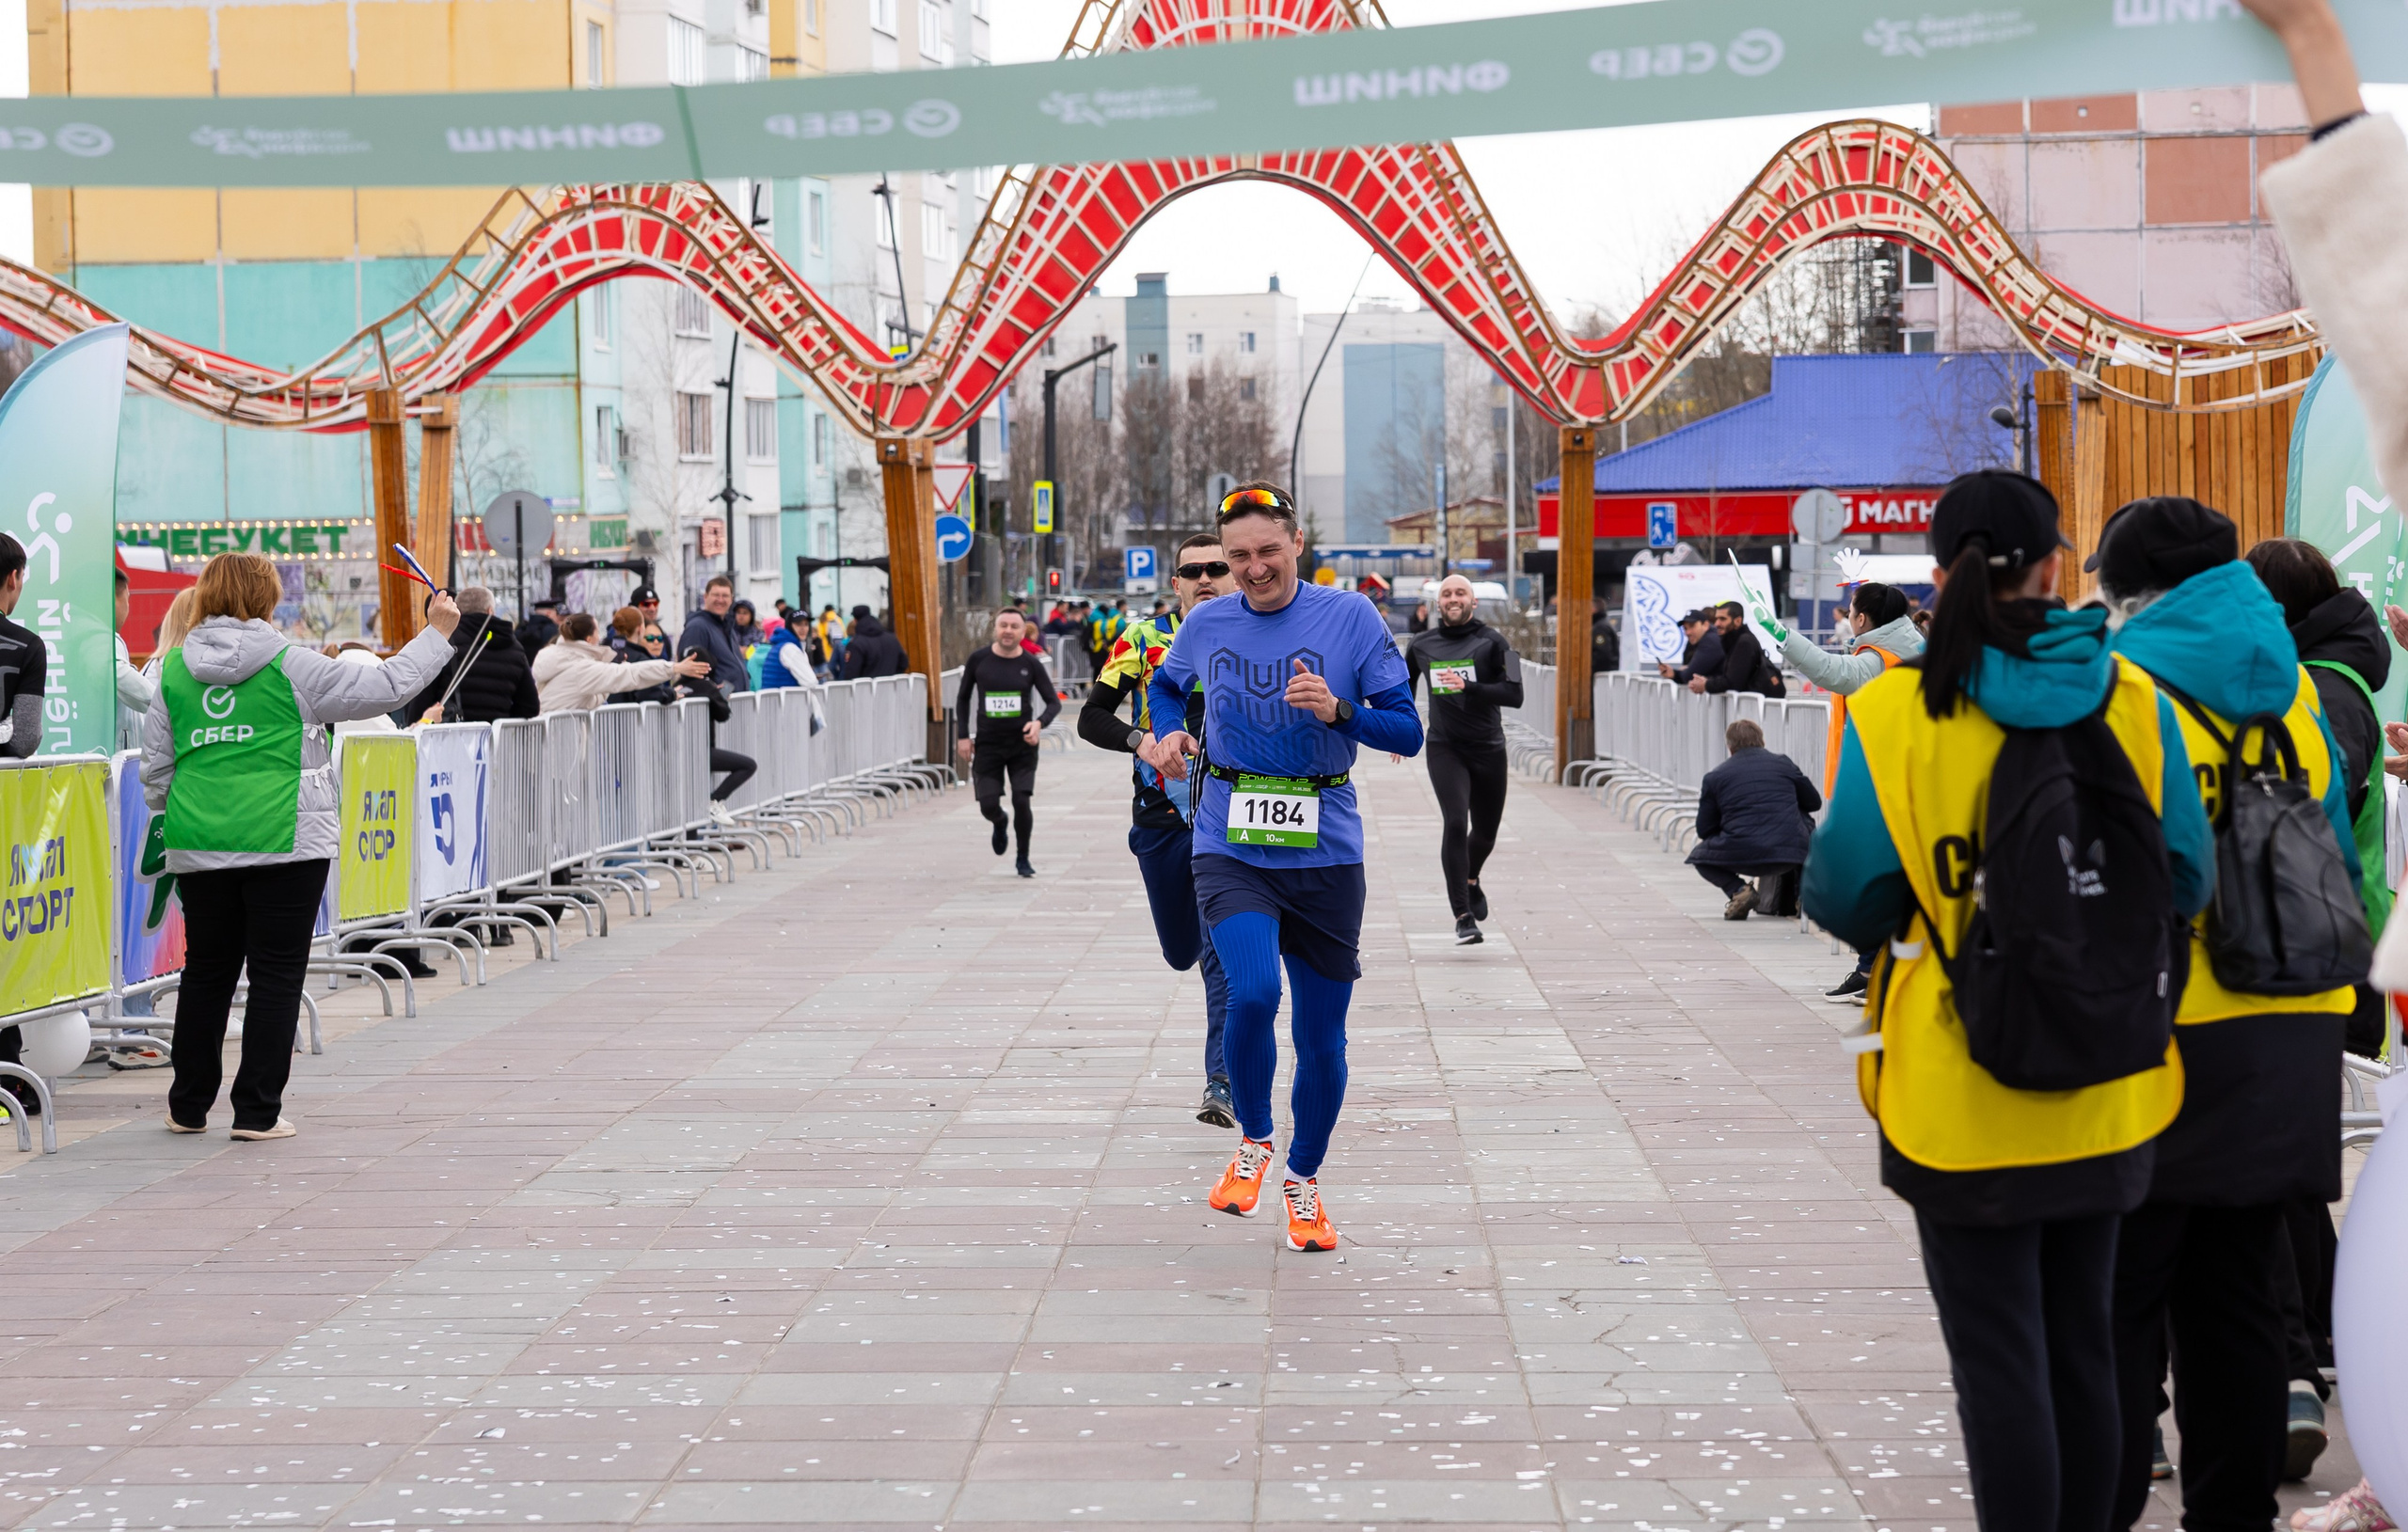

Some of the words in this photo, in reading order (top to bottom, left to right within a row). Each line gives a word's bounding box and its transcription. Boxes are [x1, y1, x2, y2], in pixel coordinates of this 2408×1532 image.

[1859, 498, 1938, 524] МАГН
[1131, 551, 1150, 576] P
[1383, 648, 1400, 661] Reeb
[992, 699, 1015, 710] 1214
[191, 724, 254, 748] СБЕР
[1244, 798, 1305, 826] 1184
[1240, 829, 1249, 841] A
[2, 887, 74, 941] СПОРТ
